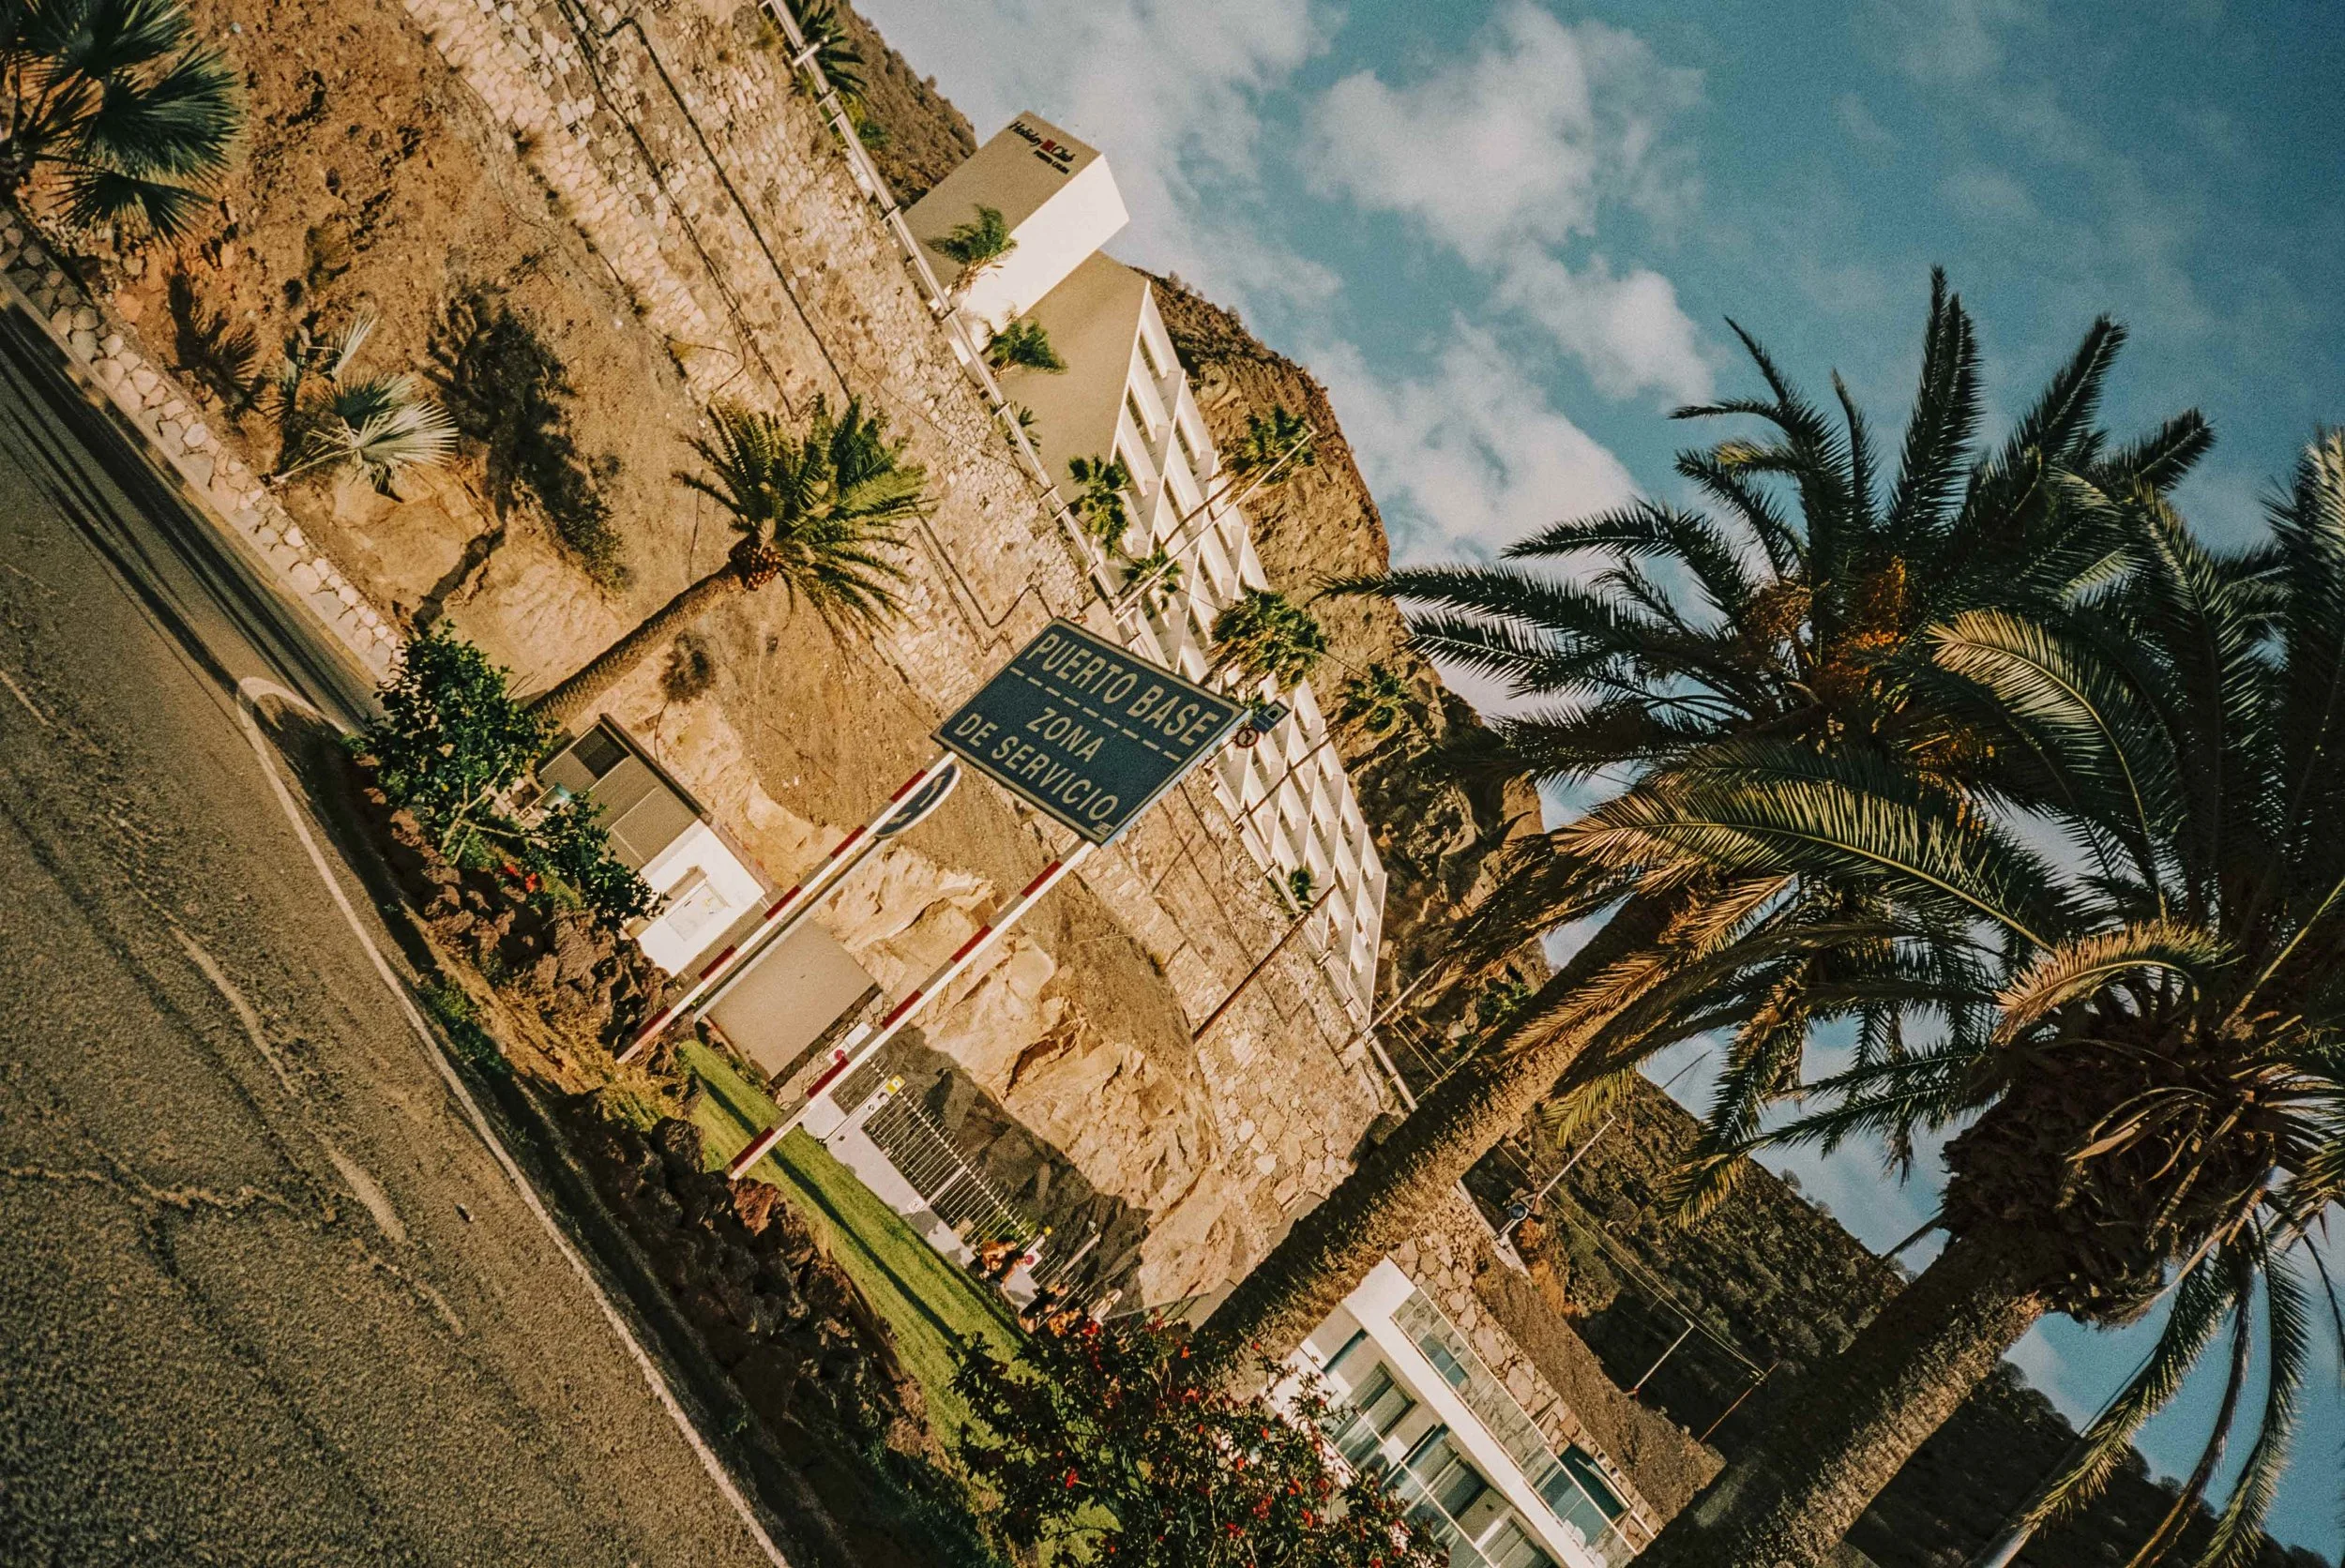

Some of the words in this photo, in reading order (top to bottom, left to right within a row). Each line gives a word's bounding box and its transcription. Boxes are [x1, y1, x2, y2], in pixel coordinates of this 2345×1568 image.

[1007, 120, 1043, 147] Holiday
[1050, 144, 1076, 162] Club
[1025, 633, 1138, 704] PUERTO
[1127, 686, 1219, 747] BASE
[954, 713, 998, 747] DE
[991, 735, 1119, 822] SERVICIO
[1025, 706, 1105, 763] ZONA
